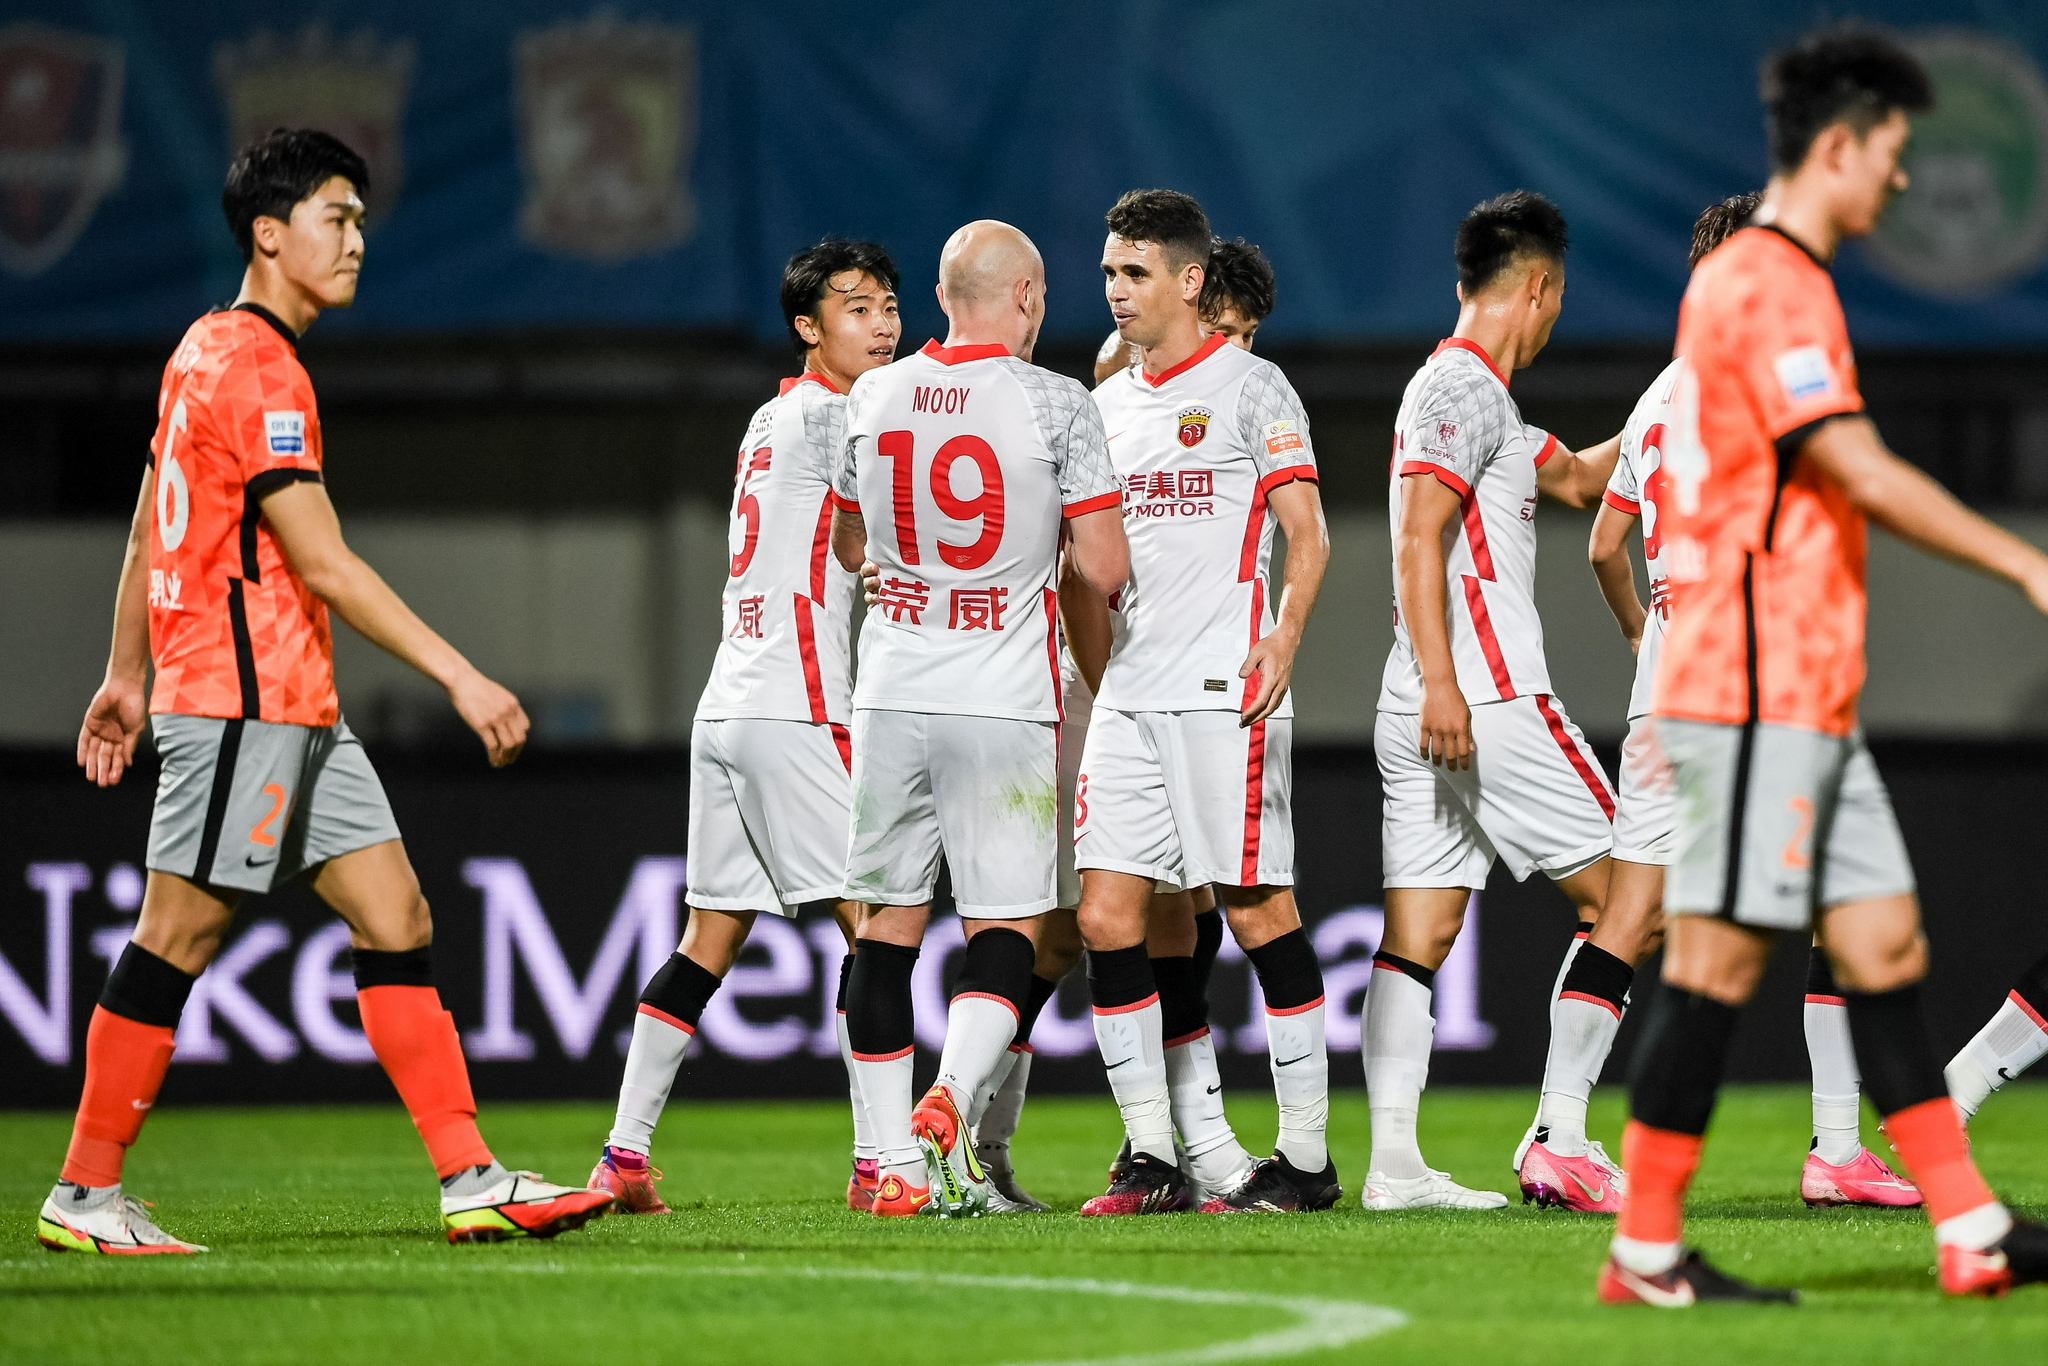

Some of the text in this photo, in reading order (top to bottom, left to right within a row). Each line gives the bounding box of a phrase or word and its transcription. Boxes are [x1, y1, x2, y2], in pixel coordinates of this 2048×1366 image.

[912, 386, 971, 415] MOOY
[157, 389, 190, 553] 6
[1420, 446, 1458, 463] ROEWE
[877, 430, 1006, 571] 19
[1135, 502, 1215, 519] MOTOR
[722, 595, 765, 639] 威
[880, 577, 1008, 630] 荣威
[249, 783, 298, 848] 2
